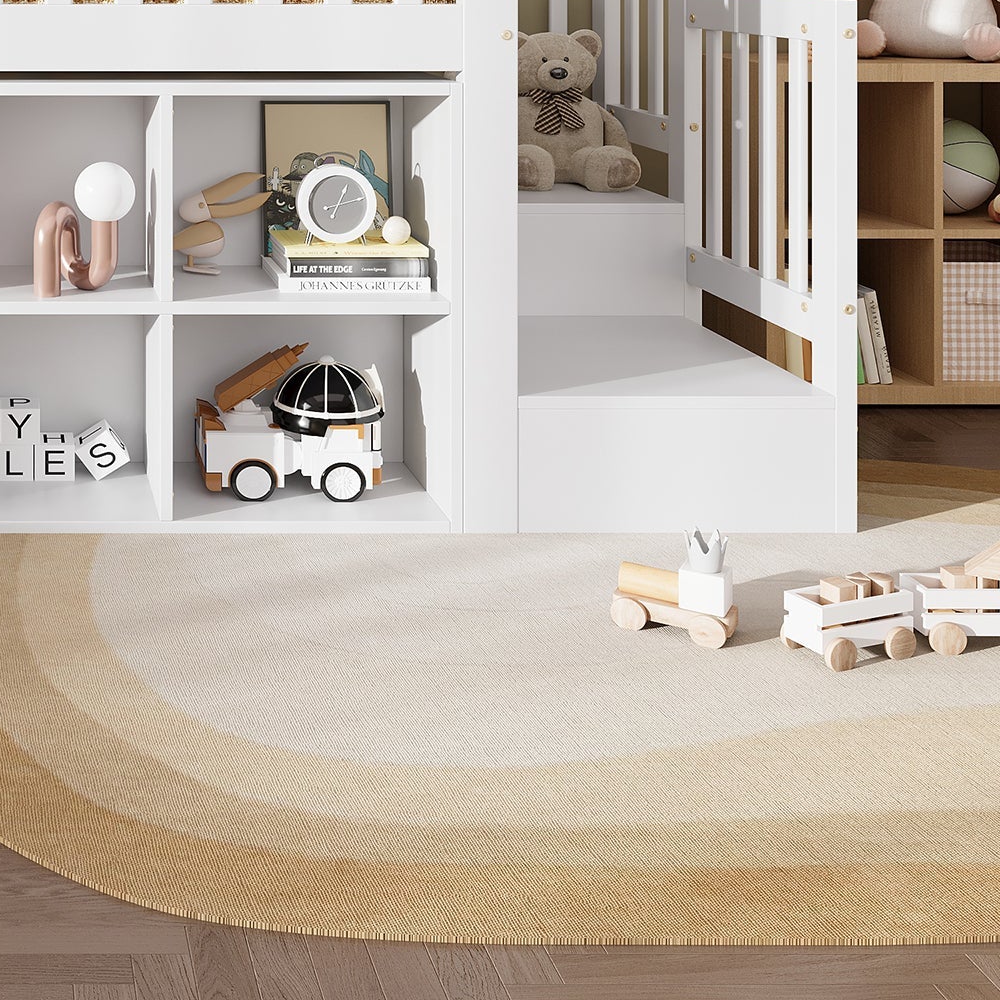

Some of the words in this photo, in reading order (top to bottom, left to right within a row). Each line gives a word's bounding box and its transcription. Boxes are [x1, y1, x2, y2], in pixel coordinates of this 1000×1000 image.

[293, 265, 308, 274] LIFE
[308, 265, 318, 274] AT
[318, 265, 333, 274] THE
[333, 265, 353, 274] EDGE
[299, 280, 363, 292] JOHANNES
